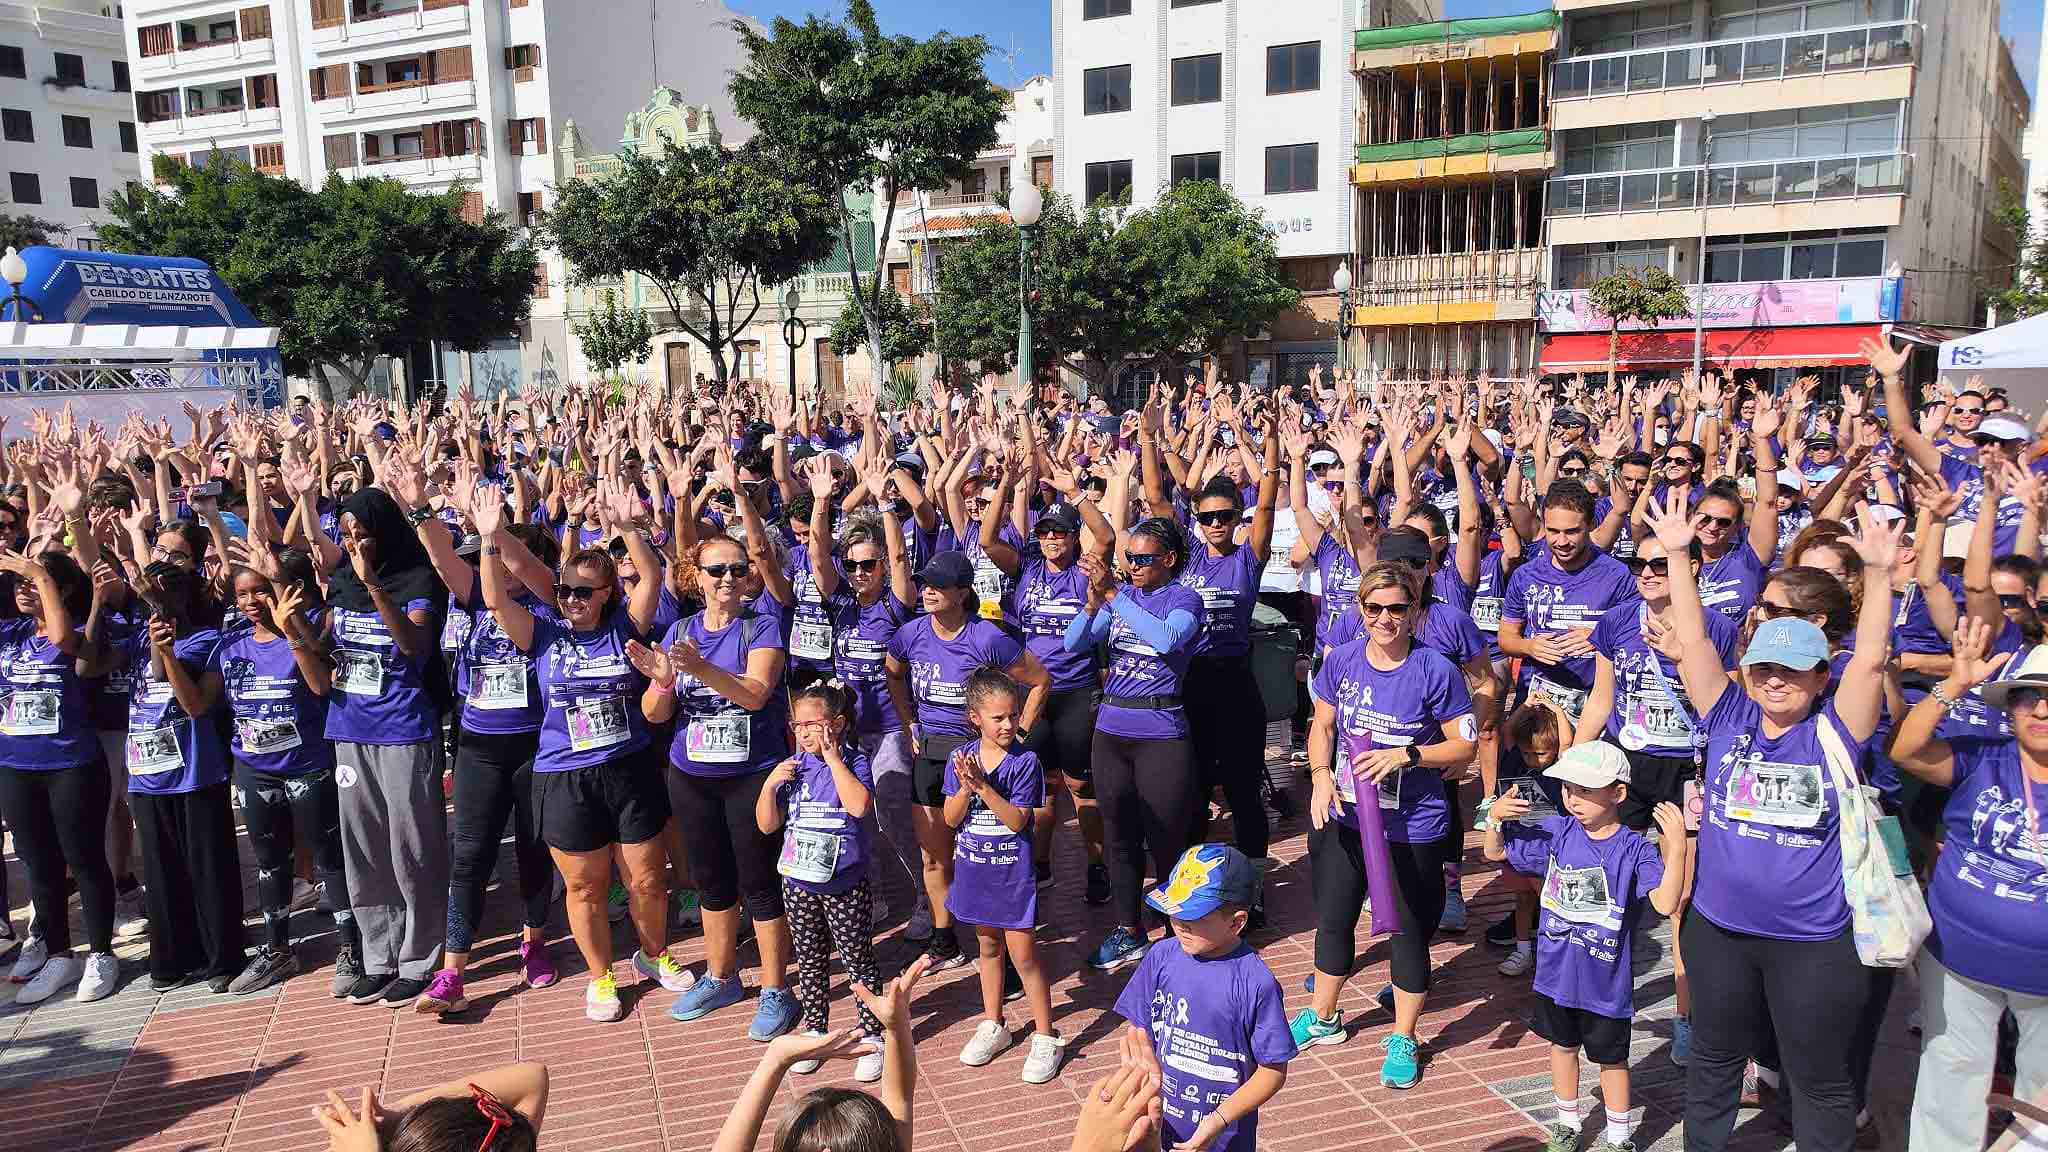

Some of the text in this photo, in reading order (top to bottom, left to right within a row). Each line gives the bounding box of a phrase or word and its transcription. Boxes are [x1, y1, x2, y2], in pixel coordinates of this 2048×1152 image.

[75, 263, 212, 290] DEPORTES
[90, 288, 211, 302] CABILDO DE LANZAROTE
[1048, 503, 1062, 514] NY
[1751, 782, 1796, 803] 016
